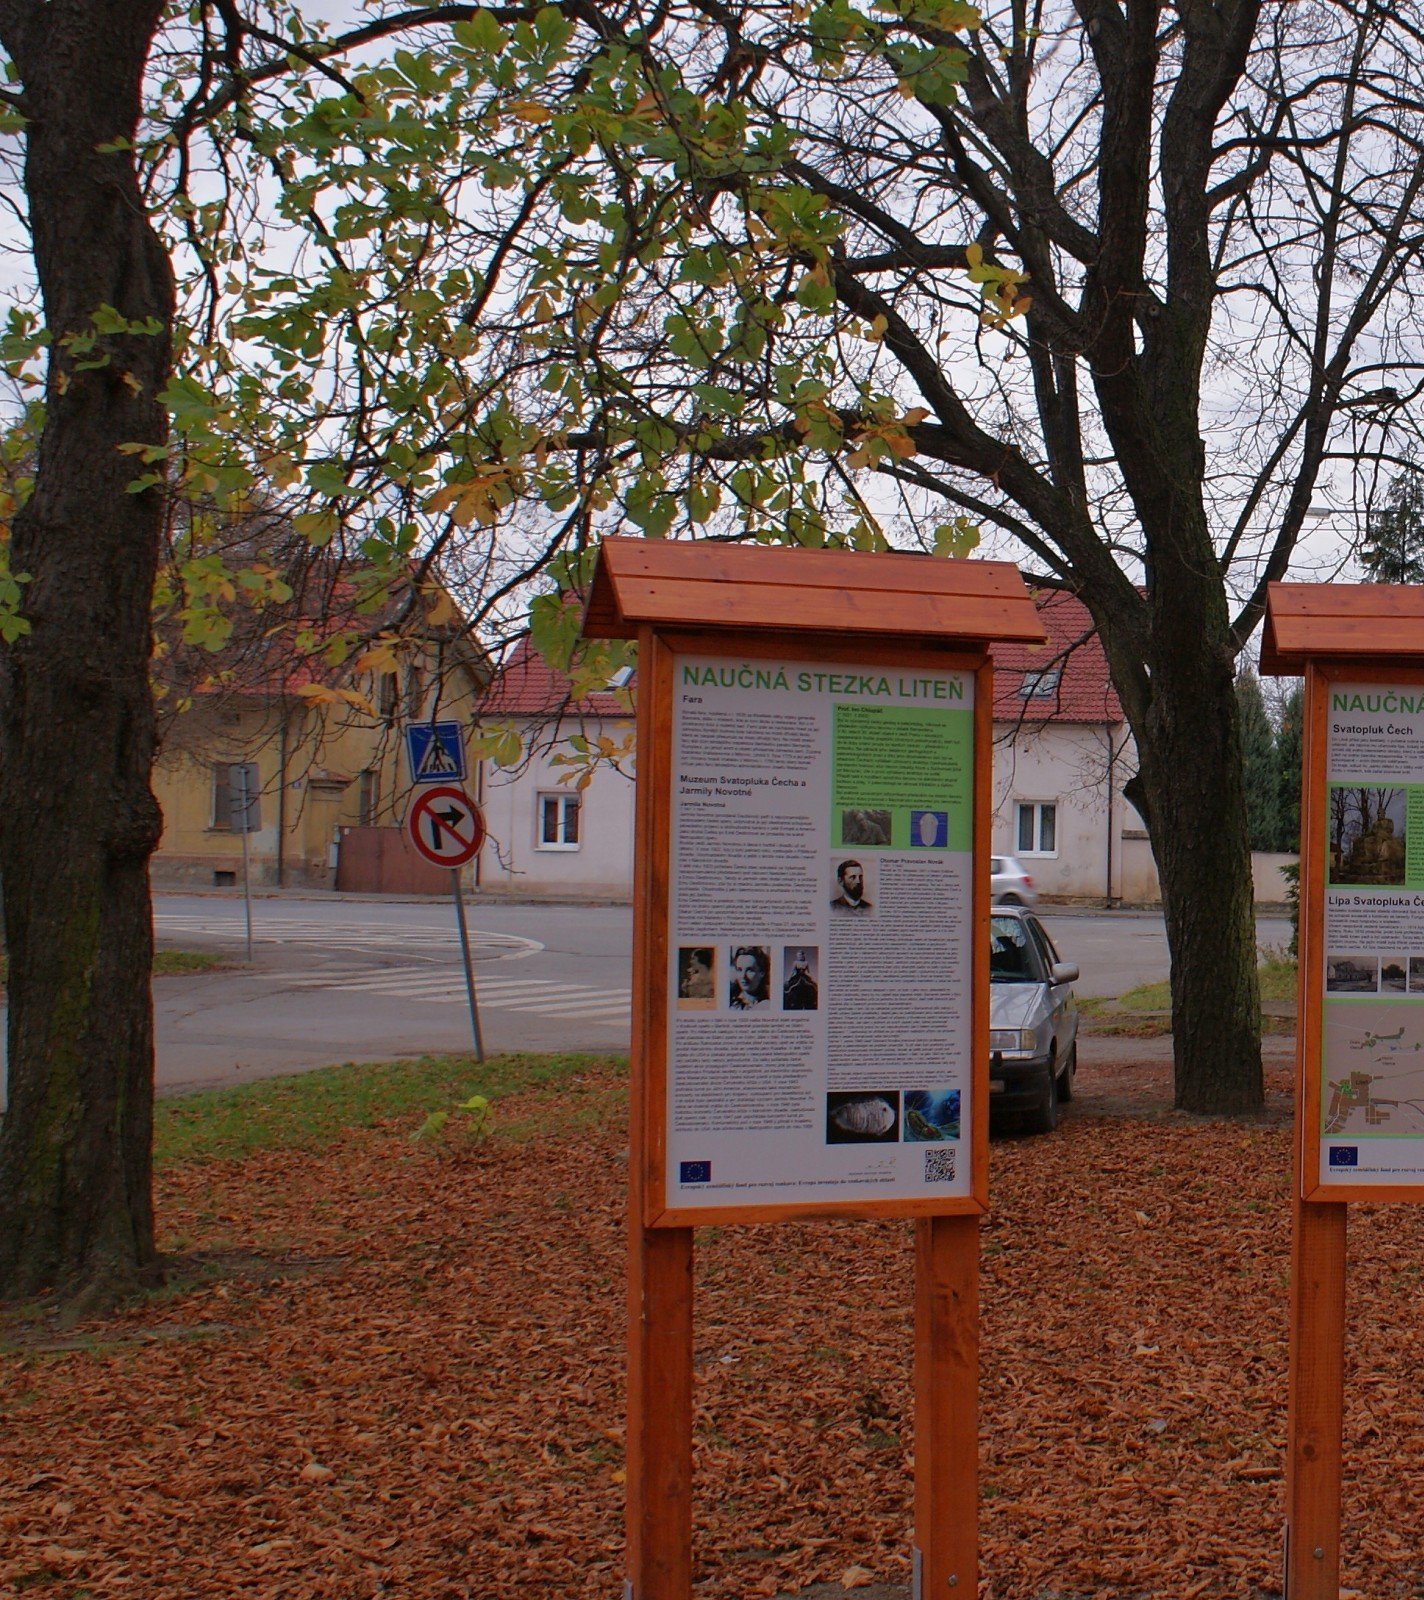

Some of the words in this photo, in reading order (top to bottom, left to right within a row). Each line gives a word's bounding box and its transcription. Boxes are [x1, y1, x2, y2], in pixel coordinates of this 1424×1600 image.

[682, 664, 789, 691] NAUČNÁ
[798, 671, 891, 696] STEZKA
[898, 676, 964, 700] LITEŇ
[682, 695, 703, 704] Fara
[1333, 724, 1384, 737] Svatopluk
[1387, 723, 1413, 736] Čech
[680, 775, 718, 784] Muzeum
[720, 776, 770, 787] Svatopluka
[771, 776, 799, 787] Čecha
[680, 787, 712, 797] Jarmily
[715, 788, 753, 797] Novotné
[1354, 896, 1411, 908] Svatopluka
